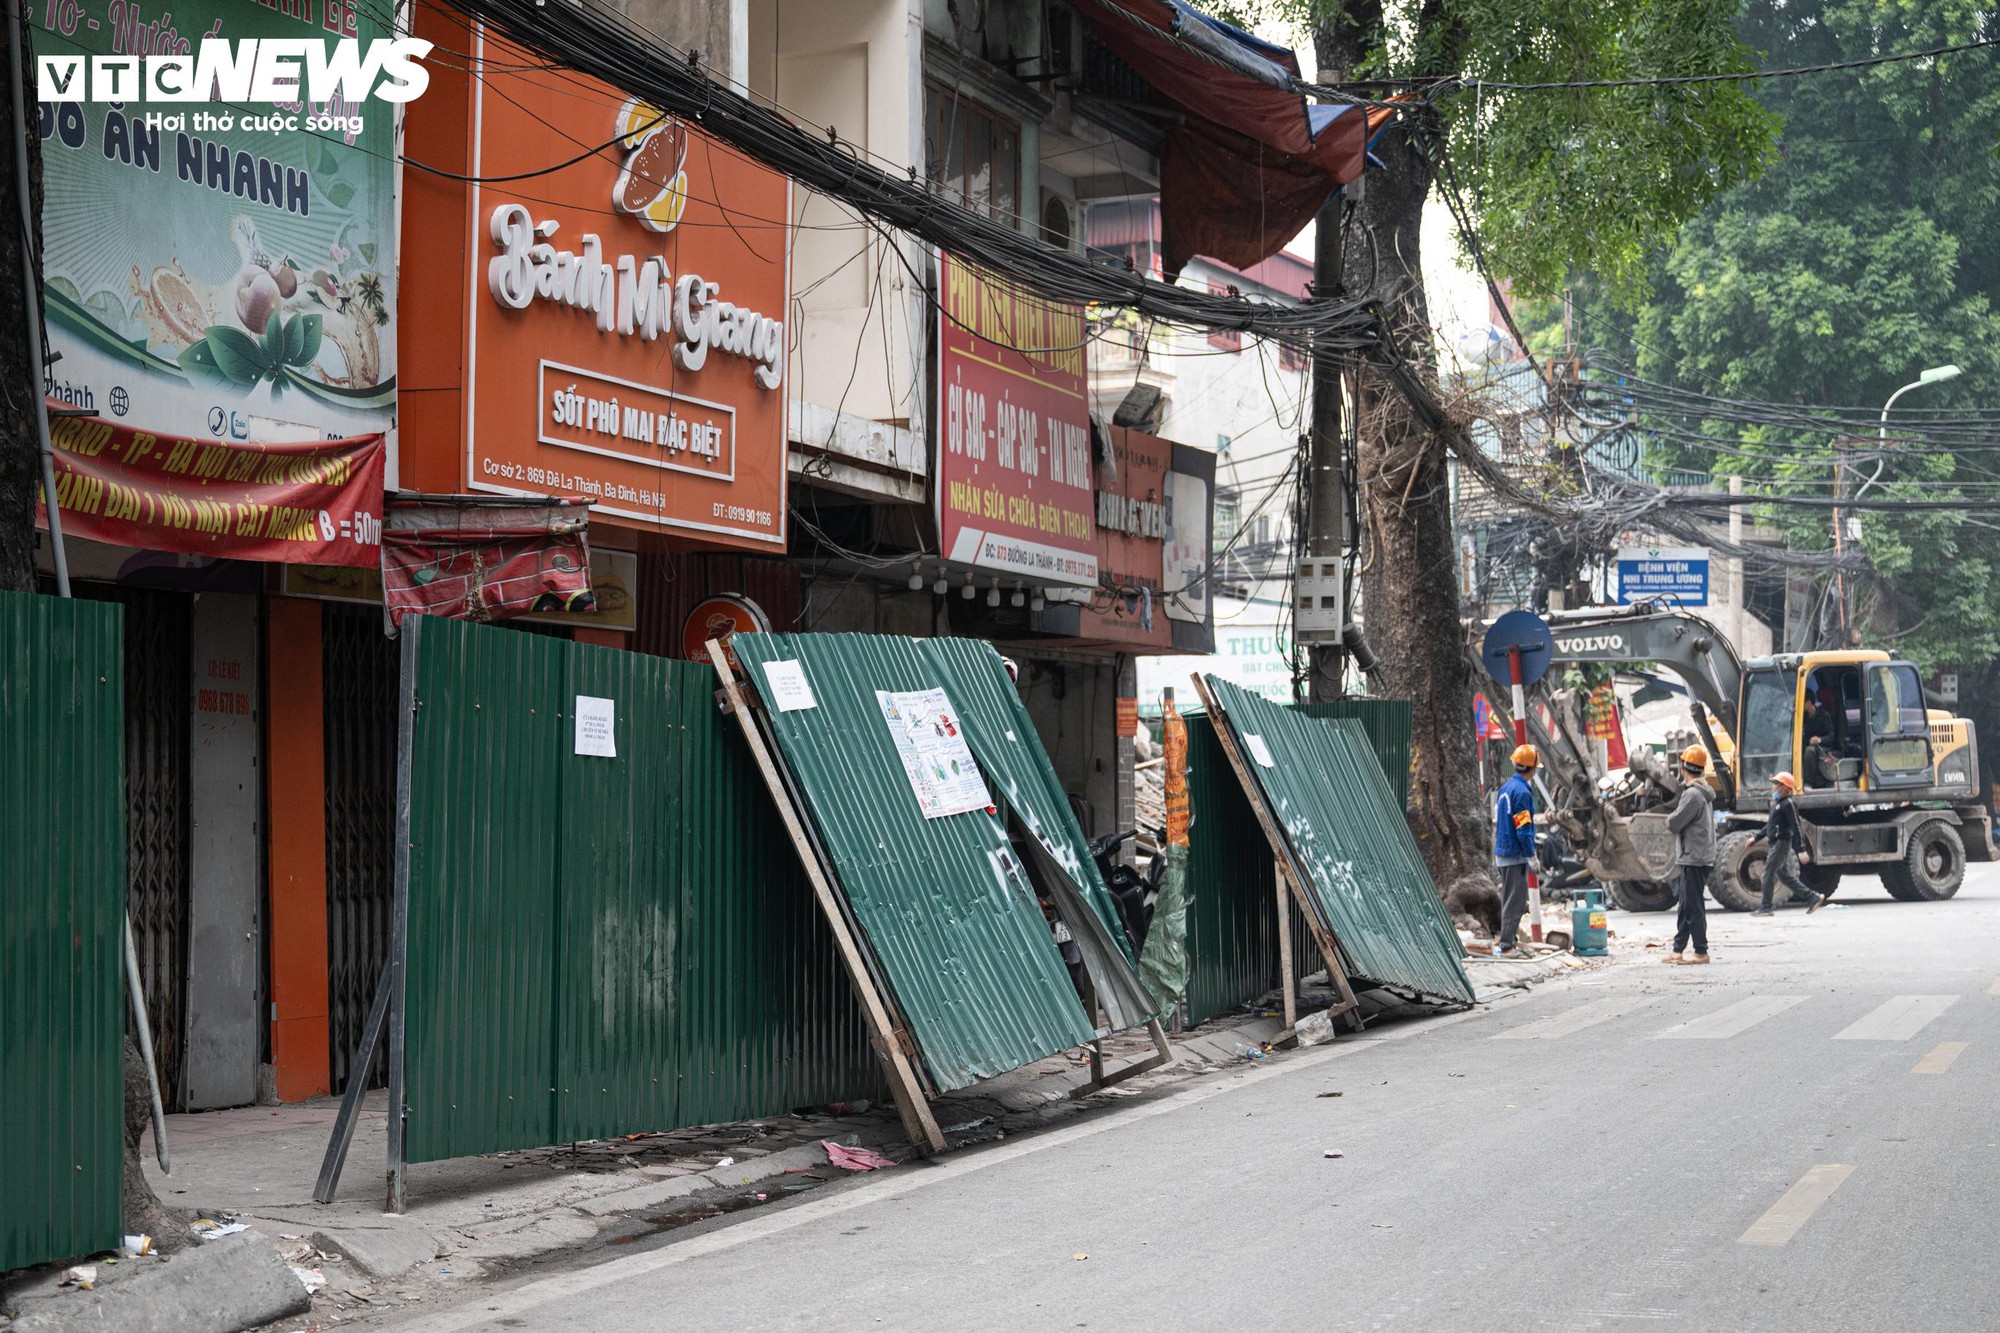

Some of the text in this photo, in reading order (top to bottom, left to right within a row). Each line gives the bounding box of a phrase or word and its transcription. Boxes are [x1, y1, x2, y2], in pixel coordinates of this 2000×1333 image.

[176, 131, 309, 217] NHANH
[488, 204, 783, 390] Bánh Mì Giang
[950, 256, 976, 352] PHỤ
[552, 384, 722, 463] SỐT PHÔ MAI ĐẶC BIỆT
[949, 365, 962, 455] CỦ
[966, 388, 985, 474] SẠC
[997, 389, 1016, 470] CÁP
[1019, 407, 1038, 489] SẠC
[1048, 417, 1063, 484] TAI
[1064, 423, 1090, 491] NGHE
[121, 432, 157, 465] TP
[161, 437, 198, 475] HÀ
[190, 441, 235, 486] NỘI
[255, 453, 288, 485] THU
[483, 457, 666, 511] Cơ sở 2: 869 Đê La Thành, Ba Đình, Hà Nội
[103, 481, 141, 521] ĐAI
[144, 491, 156, 524] 1
[190, 495, 232, 541] MẶT
[236, 493, 269, 538] CẮT
[265, 505, 318, 542] NGANG
[318, 509, 336, 542] B
[728, 505, 744, 521] 0919
[746, 508, 756, 524] 90
[756, 512, 772, 527] 1166
[950, 478, 1091, 546] NHẬN SỬA CHỮA ĐIỆN THOẠI
[985, 542, 996, 560] ĐC:
[997, 545, 1007, 560] 873
[1008, 545, 1028, 566] ĐƯỜNG
[1028, 551, 1036, 567] LA
[1036, 551, 1054, 571] THÀNH
[1623, 572, 1703, 584] NHI TRUNG ƯƠNG
[1638, 561, 1689, 575] BỆNH VIỆN
[692, 649, 711, 663] Bán
[1555, 634, 1623, 654] VOLVO
